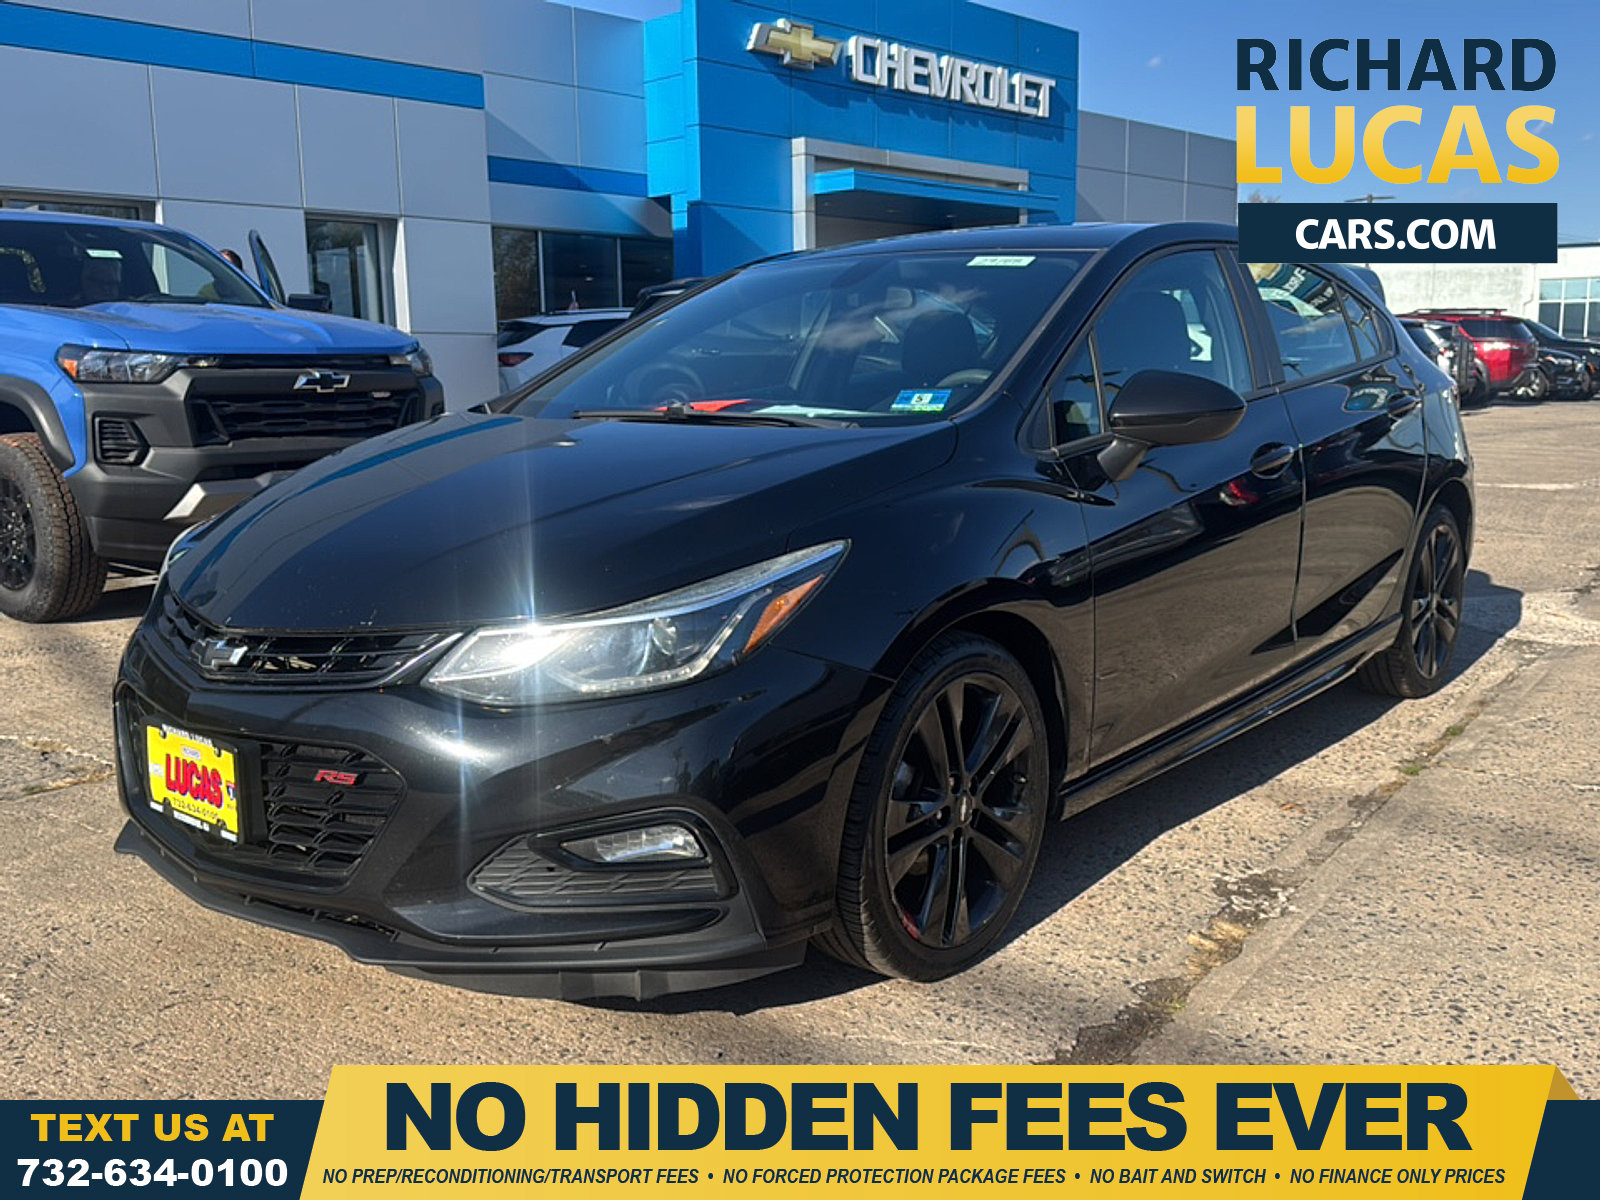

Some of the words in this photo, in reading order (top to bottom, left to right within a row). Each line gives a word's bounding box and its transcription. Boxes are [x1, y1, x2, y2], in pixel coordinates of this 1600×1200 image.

[849, 35, 1056, 118] CHEVROLET
[165, 753, 223, 809] LUCAS
[314, 769, 358, 785] RS
